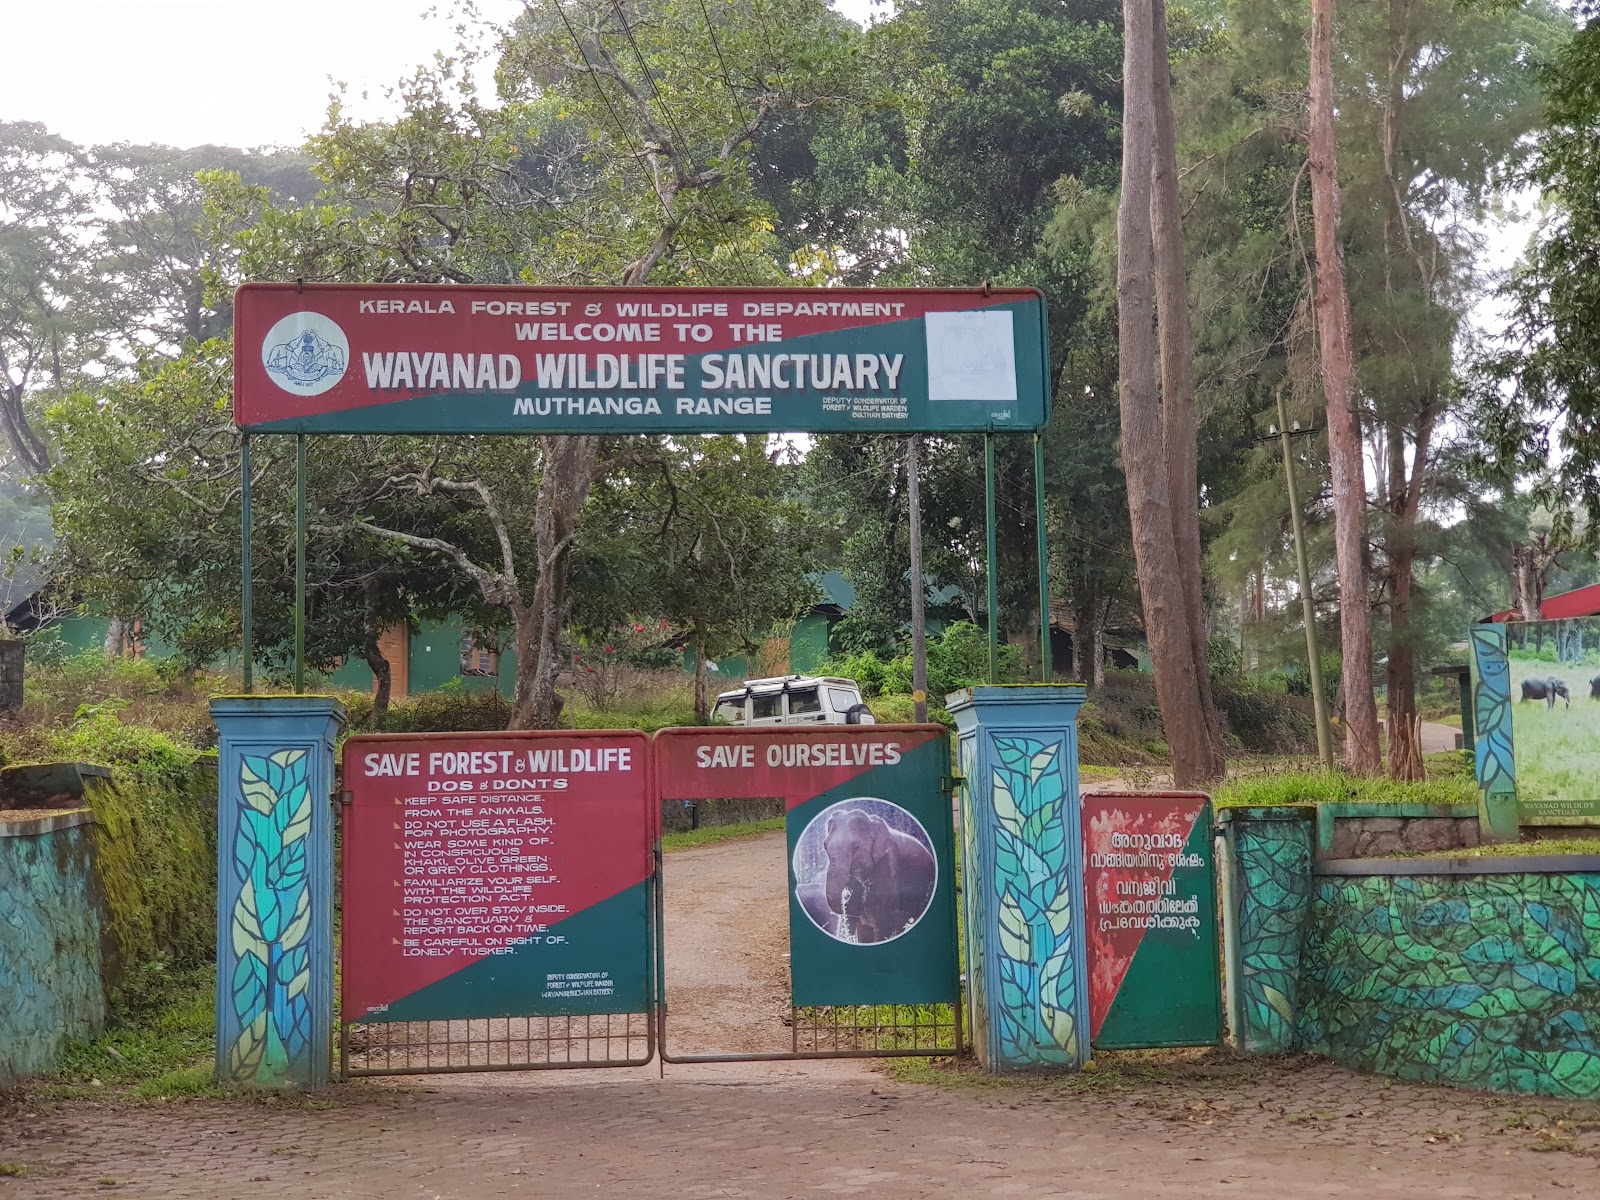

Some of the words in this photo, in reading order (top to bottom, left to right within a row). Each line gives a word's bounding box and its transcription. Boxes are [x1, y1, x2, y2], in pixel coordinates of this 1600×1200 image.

[360, 300, 455, 313] KERALA
[472, 301, 571, 315] FOREST
[585, 303, 602, 316] &
[616, 303, 728, 317] WILDLIFE
[744, 303, 905, 316] DEPARTMENT
[515, 323, 660, 341] WELCOME
[674, 324, 712, 342] TO
[729, 324, 782, 342] THE
[362, 352, 521, 389] WAYANAD
[536, 354, 684, 389] WILDLIFE
[701, 354, 903, 389] SANCTUARY
[513, 398, 662, 415] MUTHANGA
[677, 398, 771, 414] RANGE
[697, 746, 754, 768] SAVE
[767, 743, 901, 767] OURSELVES
[365, 753, 419, 776] SAVE
[430, 751, 513, 775] FOREST
[515, 759, 525, 772] &
[528, 748, 631, 772] WILDLIFE
[428, 781, 473, 791] DOS
[480, 781, 488, 790] &
[493, 779, 568, 790] DONTS
[405, 797, 437, 805] KEEP
[442, 796, 476, 804] SAFE
[479, 806, 544, 815] ANIMALS.
[405, 821, 422, 829] DO
[427, 819, 457, 829] NOT
[462, 819, 490, 828] USE
[493, 818, 505, 826] A
[441, 826, 553, 837] PHOTOGRAPHY.
[405, 841, 442, 849] WEAR
[447, 840, 488, 848] SOME
[493, 838, 524, 847] KIND
[404, 850, 417, 858] IN
[422, 847, 520, 857] CONSPICUOUS
[404, 858, 450, 867] KHAKI,
[455, 857, 496, 865] OLIVE
[1168, 852, 1205, 867] ശേഷം
[405, 867, 424, 875] OR
[428, 866, 466, 875] GREY
[470, 863, 553, 874] CLOTHINGS.
[404, 877, 484, 887] FAMILIARIZE
[487, 877, 523, 885] YOUR
[1116, 876, 1176, 897] വന്യജീവി
[404, 887, 435, 896] WITH
[471, 885, 533, 894] WILDLIFE
[404, 896, 492, 904] PROTECTION
[499, 894, 535, 903] ACT.
[425, 907, 452, 916] NOT
[455, 907, 489, 916] OVER
[492, 905, 527, 914] STAY
[434, 915, 520, 924] SANCTUARY
[525, 914, 533, 923] &
[1100, 914, 1200, 932] പ്രവേശിക്കുക
[404, 926, 454, 934] REPORT
[458, 925, 491, 934] BACK
[493, 925, 513, 933] ON
[516, 923, 550, 933] TIME.
[424, 937, 483, 947] CAREFUL
[485, 938, 503, 946] ON
[505, 936, 542, 946] SIGHT
[404, 948, 454, 956] LONELY
[460, 946, 518, 956] TUSKER.
